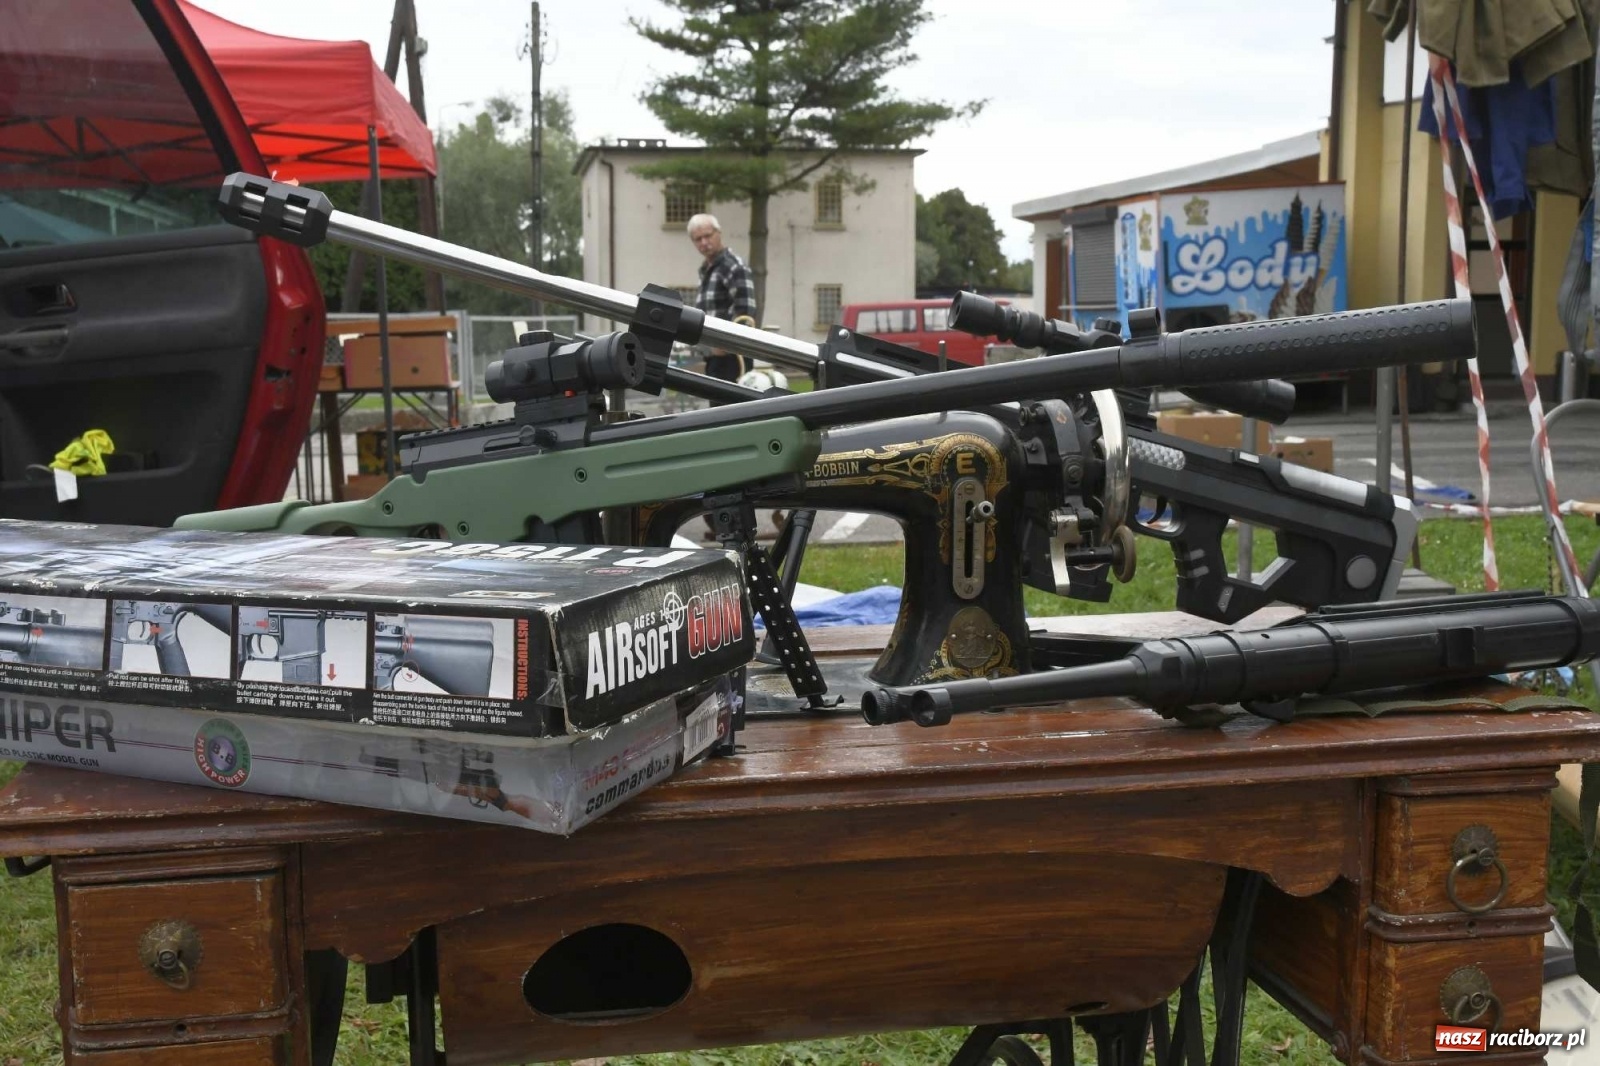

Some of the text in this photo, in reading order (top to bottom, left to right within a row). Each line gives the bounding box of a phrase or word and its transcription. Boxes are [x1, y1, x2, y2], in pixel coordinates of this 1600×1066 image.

[1172, 237, 1320, 294] Lody
[957, 453, 976, 474] E
[634, 611, 656, 630] AGES
[585, 583, 743, 700] AIRSOFT GUN
[278, 692, 294, 700] down
[12, 749, 46, 760] PLASTIC
[47, 753, 79, 765] MODEL
[80, 757, 99, 767] GUN
[197, 738, 210, 772] HIGH
[210, 769, 246, 784] POWER
